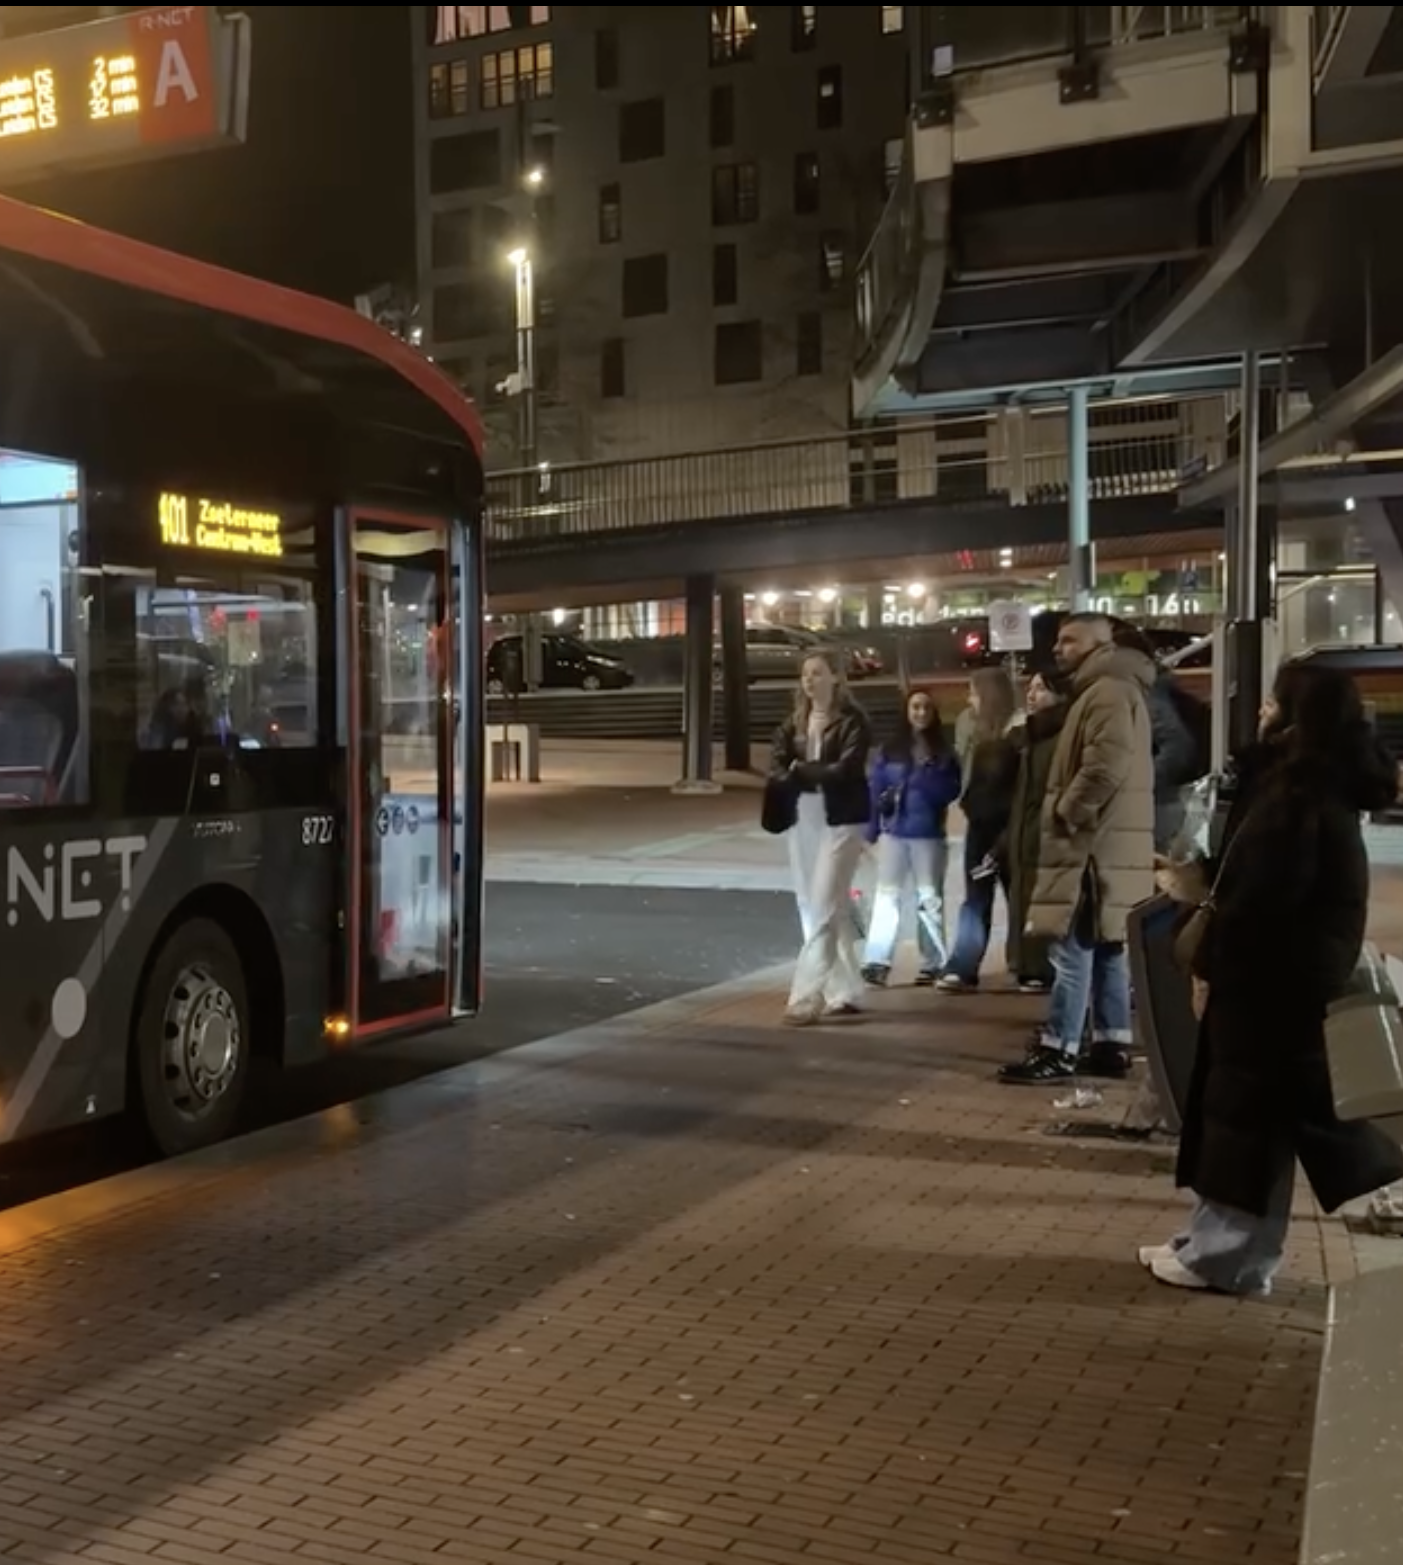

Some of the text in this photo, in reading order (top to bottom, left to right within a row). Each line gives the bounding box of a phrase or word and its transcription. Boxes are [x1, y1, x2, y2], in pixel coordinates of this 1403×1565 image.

[34, 69, 53, 90] CS
[108, 55, 135, 75] min
[154, 39, 198, 107] A
[36, 89, 56, 109] CS
[111, 75, 137, 95] min
[39, 108, 58, 128] CS
[113, 95, 139, 115] min
[302, 815, 335, 846] 8727
